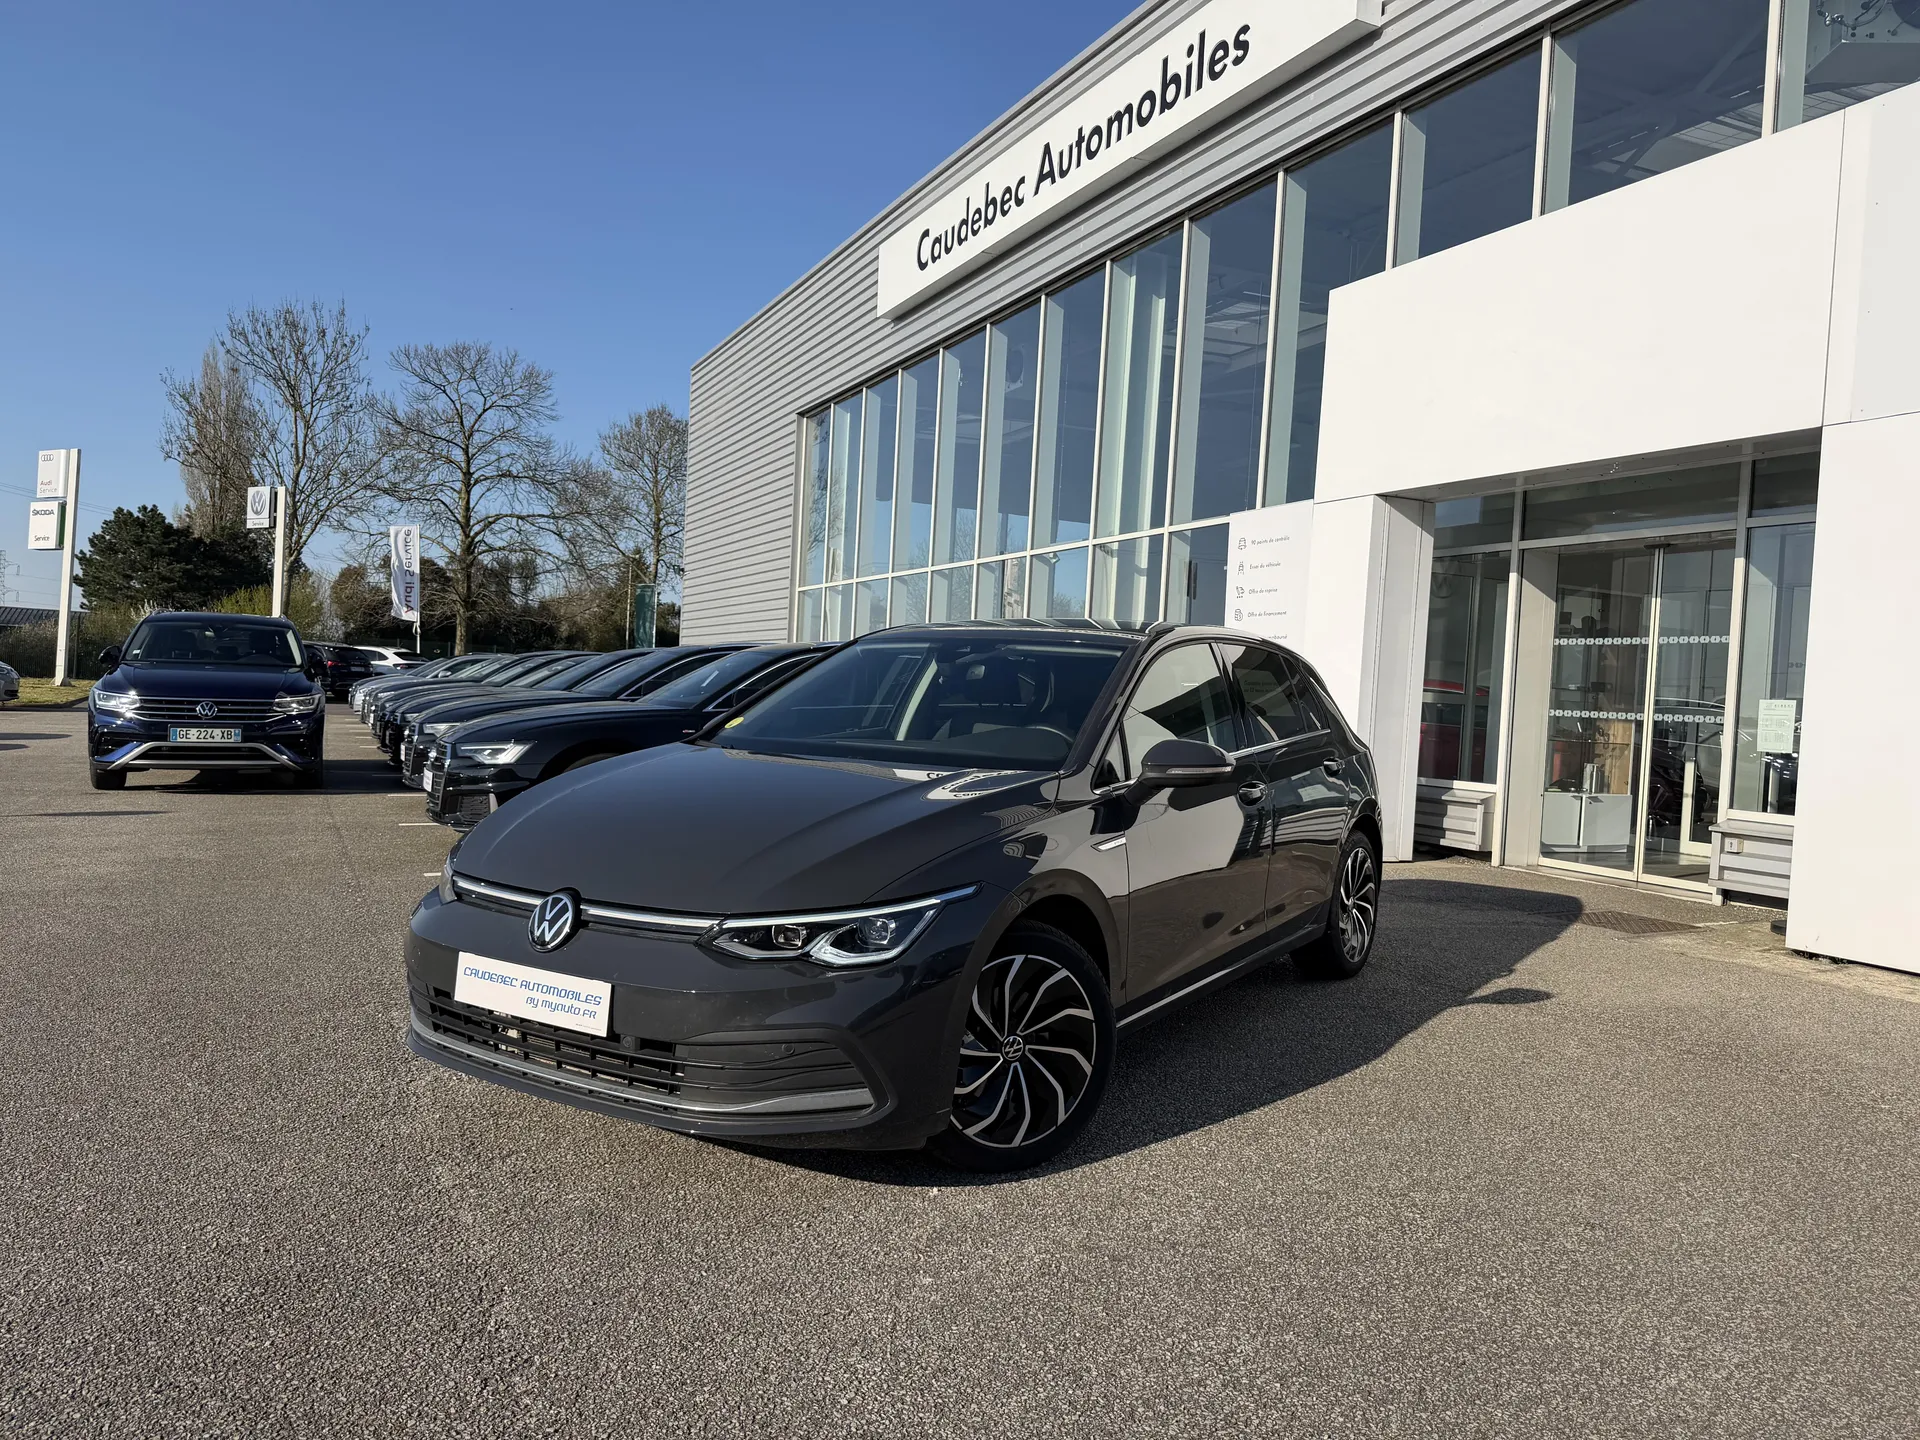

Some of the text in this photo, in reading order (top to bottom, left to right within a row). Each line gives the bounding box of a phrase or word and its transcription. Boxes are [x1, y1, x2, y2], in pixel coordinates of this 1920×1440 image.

[917, 23, 1251, 271] Caudebec Automobiles
[178, 730, 233, 740] GE-224-XB
[464, 966, 602, 1006] CAUDEBEC AUTOMOBILES
